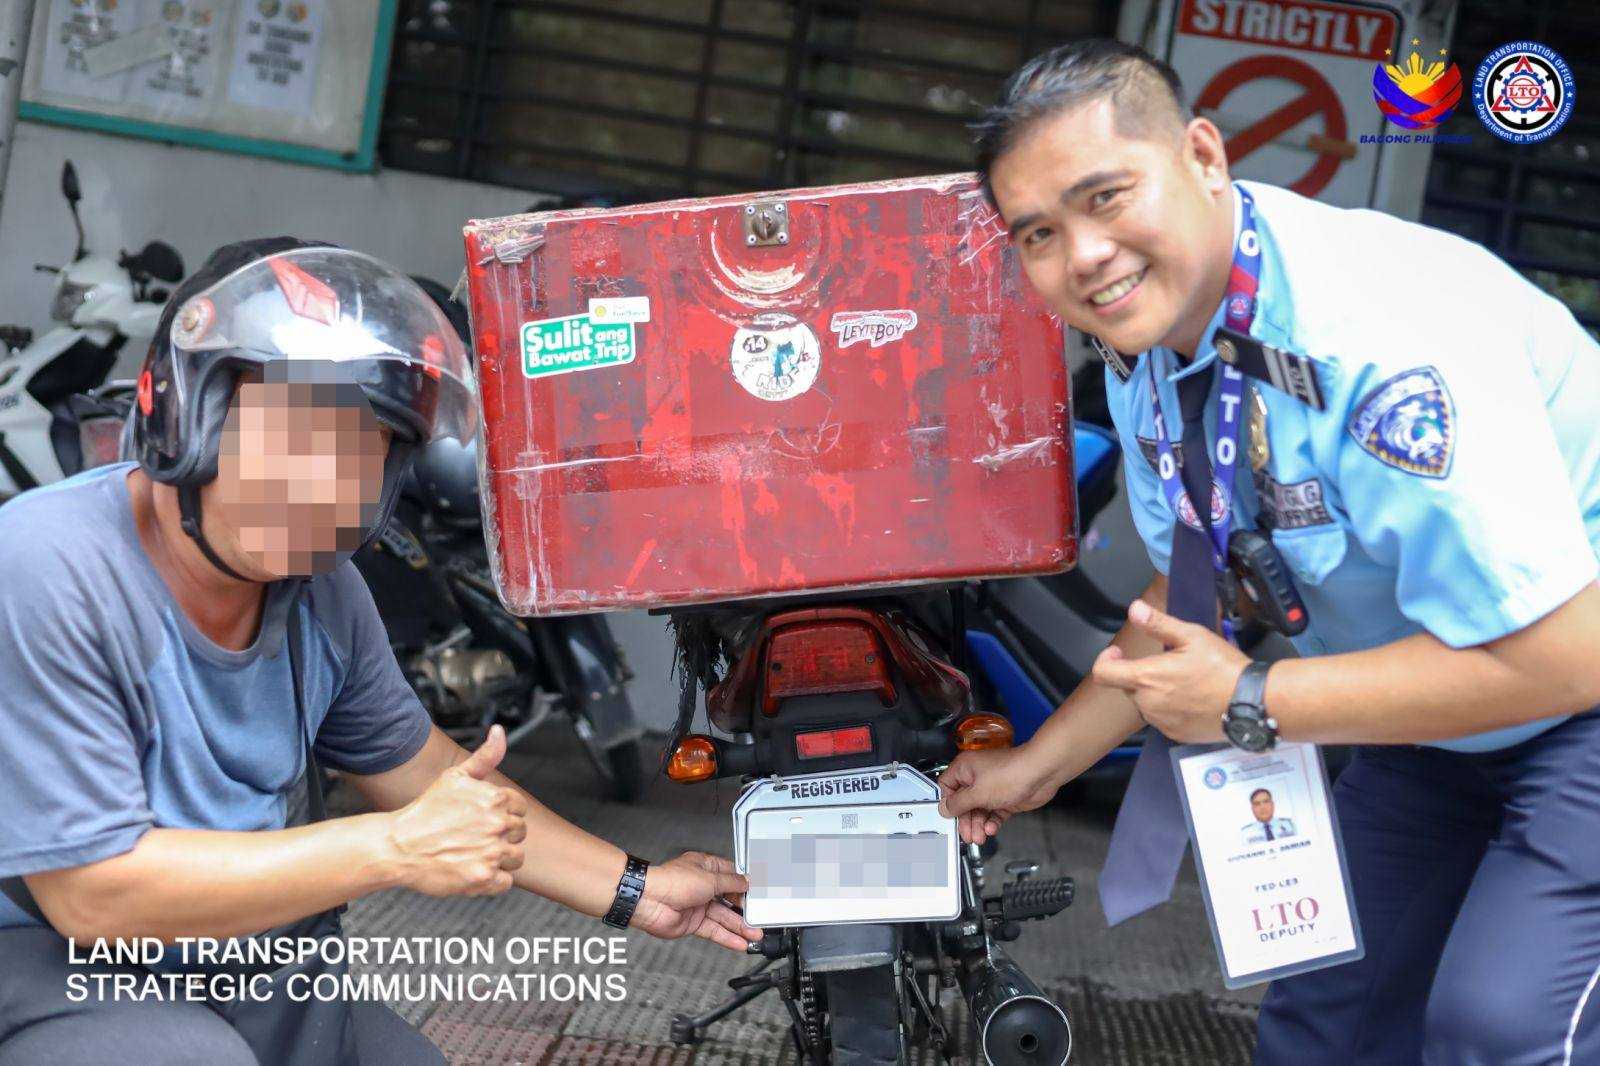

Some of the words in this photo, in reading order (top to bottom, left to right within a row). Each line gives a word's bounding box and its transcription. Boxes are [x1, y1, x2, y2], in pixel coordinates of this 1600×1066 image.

[1191, 0, 1382, 55] STRICTLY
[525, 319, 594, 353] Sulit
[594, 328, 628, 344] ang
[528, 345, 592, 369] Bawat
[593, 340, 630, 362] Trip
[790, 776, 880, 799] REGISTERED
[1251, 896, 1320, 931] LTO
[1259, 922, 1316, 943] DEPUTY
